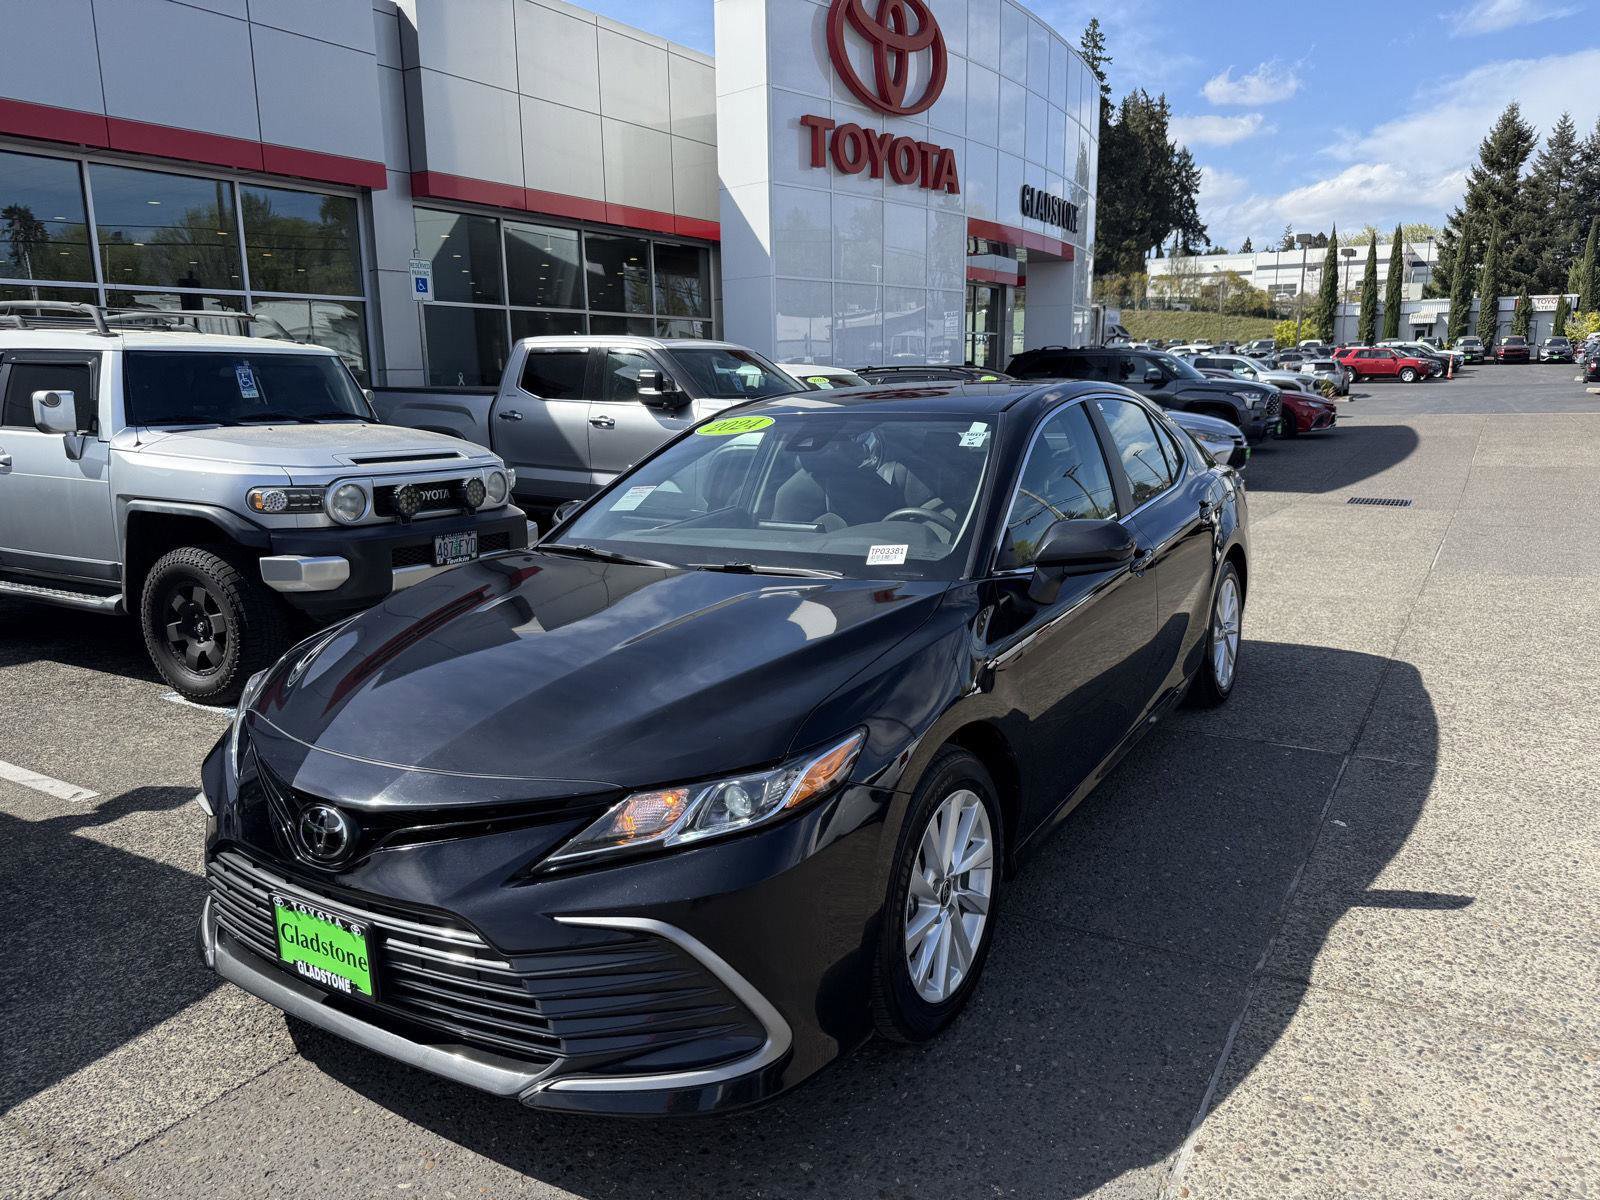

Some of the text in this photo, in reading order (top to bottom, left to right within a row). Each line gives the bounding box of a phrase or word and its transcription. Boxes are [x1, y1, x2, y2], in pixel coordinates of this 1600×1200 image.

[800, 114, 960, 194] TOYOTA
[1020, 184, 1079, 234] GLADSTONE
[410, 261, 430, 269] RESERVED
[704, 418, 766, 433] 2024
[871, 547, 904, 555] TP03381
[290, 901, 343, 928] TOYOTA
[280, 921, 369, 973] Gladstone
[296, 960, 352, 994] GLADSTONE
